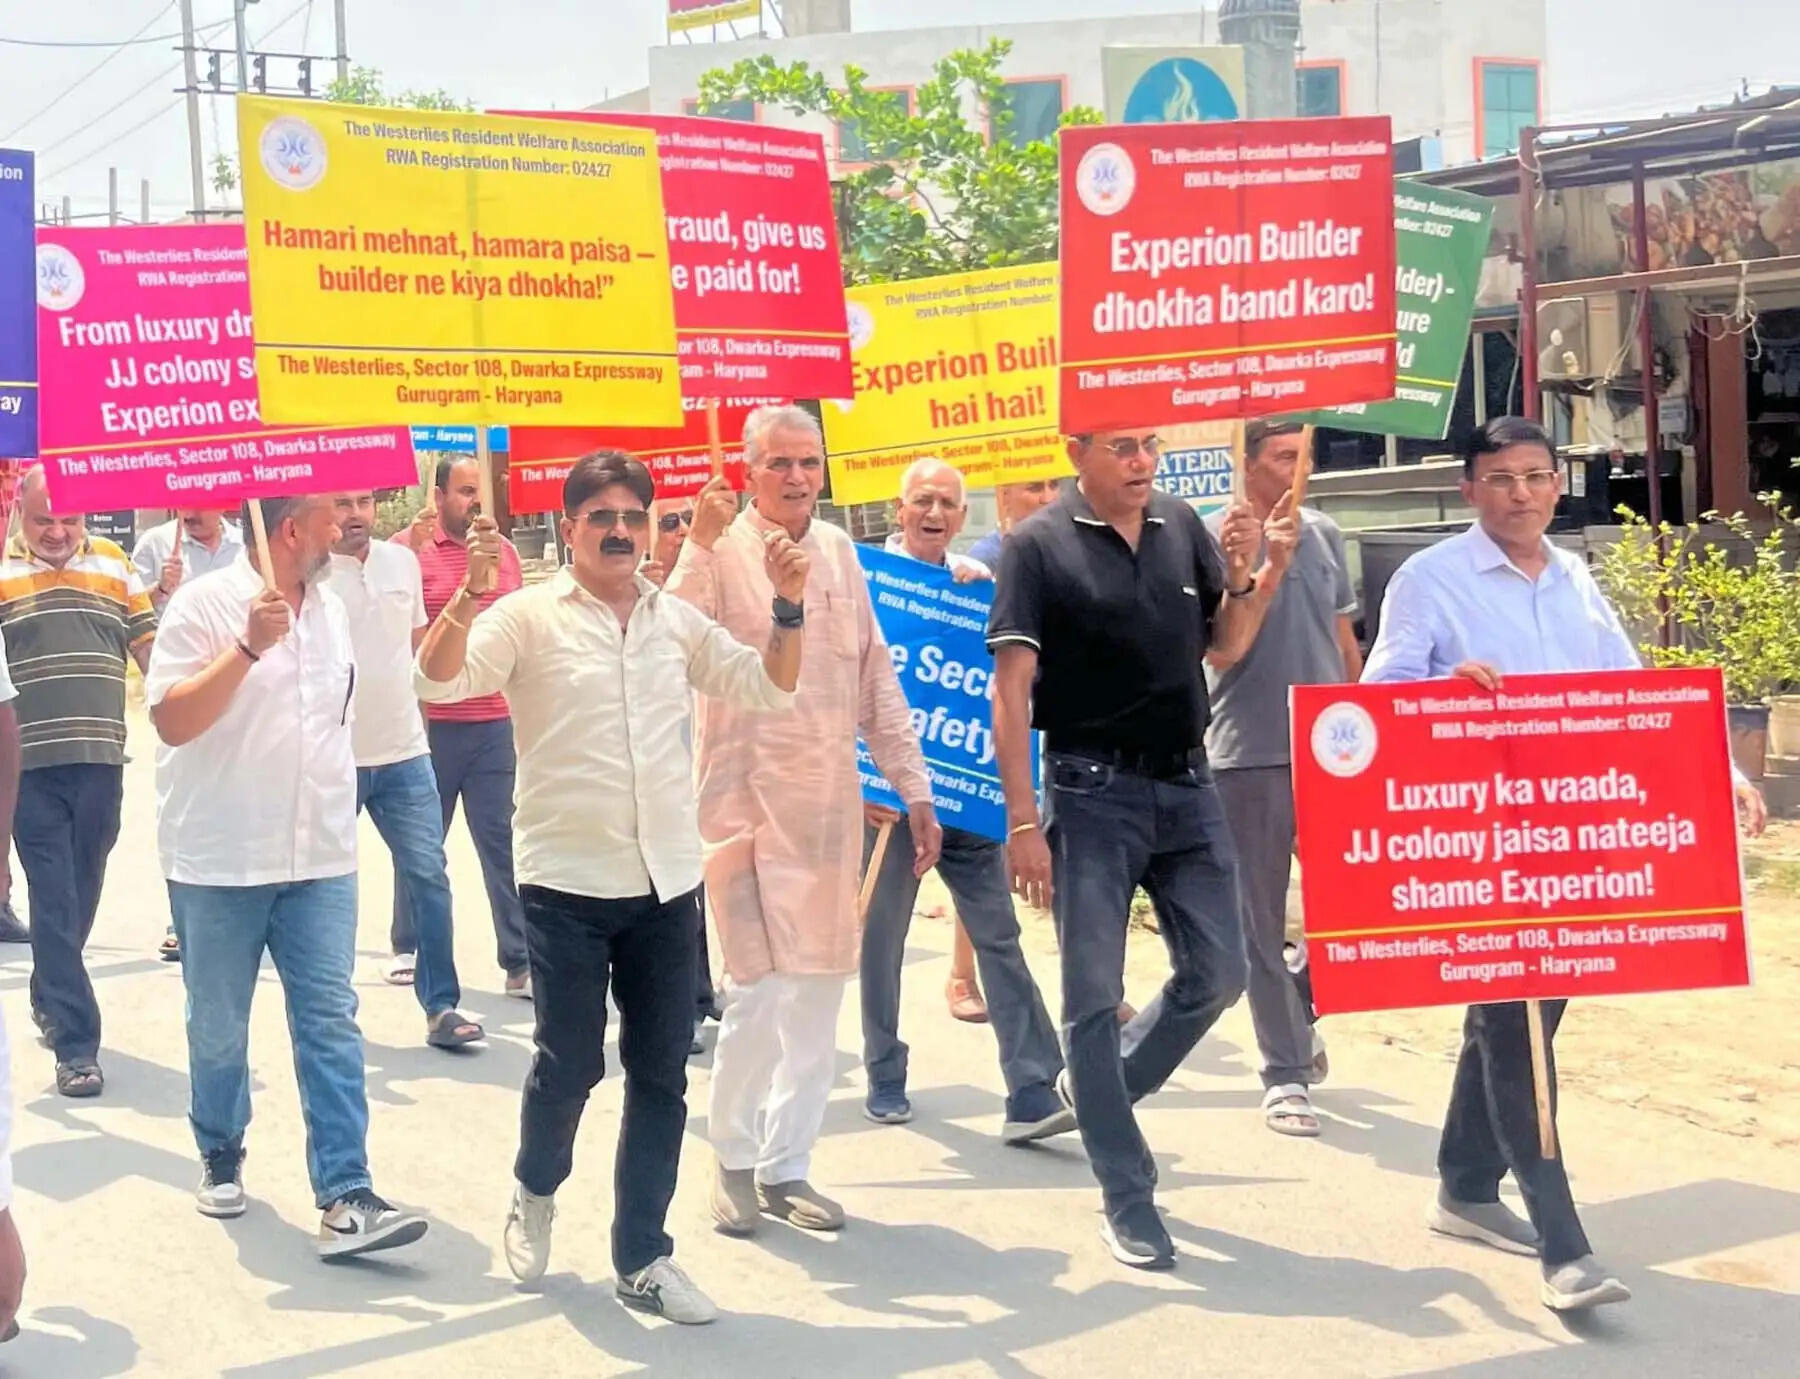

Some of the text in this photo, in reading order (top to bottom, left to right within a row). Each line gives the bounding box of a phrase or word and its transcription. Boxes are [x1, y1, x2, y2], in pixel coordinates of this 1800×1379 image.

[344, 121, 370, 137] The
[373, 123, 449, 143] Westerlies
[453, 128, 515, 147] Resident
[517, 133, 568, 151] Welfare
[571, 137, 645, 156] Association
[386, 149, 611, 177] RWA Registration Number: 02427
[263, 221, 356, 251] Hamari
[363, 227, 467, 261] mehnat,
[473, 232, 565, 259] hamara
[571, 238, 631, 265] paisa
[744, 216, 792, 250] give
[798, 225, 826, 250] us
[1111, 220, 1362, 278] Experion Builder
[98, 249, 123, 265] The
[124, 249, 192, 264] Westerlies
[138, 270, 245, 287] RWA Registration
[319, 266, 408, 293] builder
[414, 275, 445, 296] ne
[452, 271, 501, 300] kiya
[696, 260, 751, 295] paid
[758, 262, 800, 293] for!
[1093, 274, 1374, 333] dhokha band karo!
[59, 316, 130, 346] From
[136, 313, 218, 346] luxury
[105, 358, 136, 389] JJ
[145, 355, 231, 389] colony
[279, 355, 309, 374] The
[313, 357, 410, 377] Westerlies,
[414, 358, 469, 377] Sector
[474, 360, 507, 380] 108,
[511, 361, 570, 379] Dwarka
[574, 363, 663, 382] Expressway
[1078, 349, 1386, 389] The Westerlies, Sector 108, Dwarka Expressway
[396, 385, 480, 404] Gurugram
[496, 387, 562, 406] Haryana
[930, 386, 1046, 429] hai hai!
[1172, 381, 1304, 406] Gurugram Haryana
[102, 398, 224, 436] Experion
[58, 433, 397, 476] The Westerlies, Sector 108, Dwarka Expressway
[166, 470, 242, 491] Gurugram
[254, 463, 312, 483] Haryana
[1393, 686, 1710, 715] The Westerlies Resident Welfare Association
[1432, 713, 1671, 738] RWA Registration Number: 02427
[1385, 769, 1647, 813] Luxury ka vaada,
[1343, 814, 1695, 864] JJ colony jaisa nateeja
[1392, 864, 1653, 911] shame Experion!
[1326, 923, 1727, 962] The Westerlies, Sector 108, Dwarka Expressway
[1440, 962, 1524, 982] Gurugram
[1540, 954, 1615, 976] Haryana
